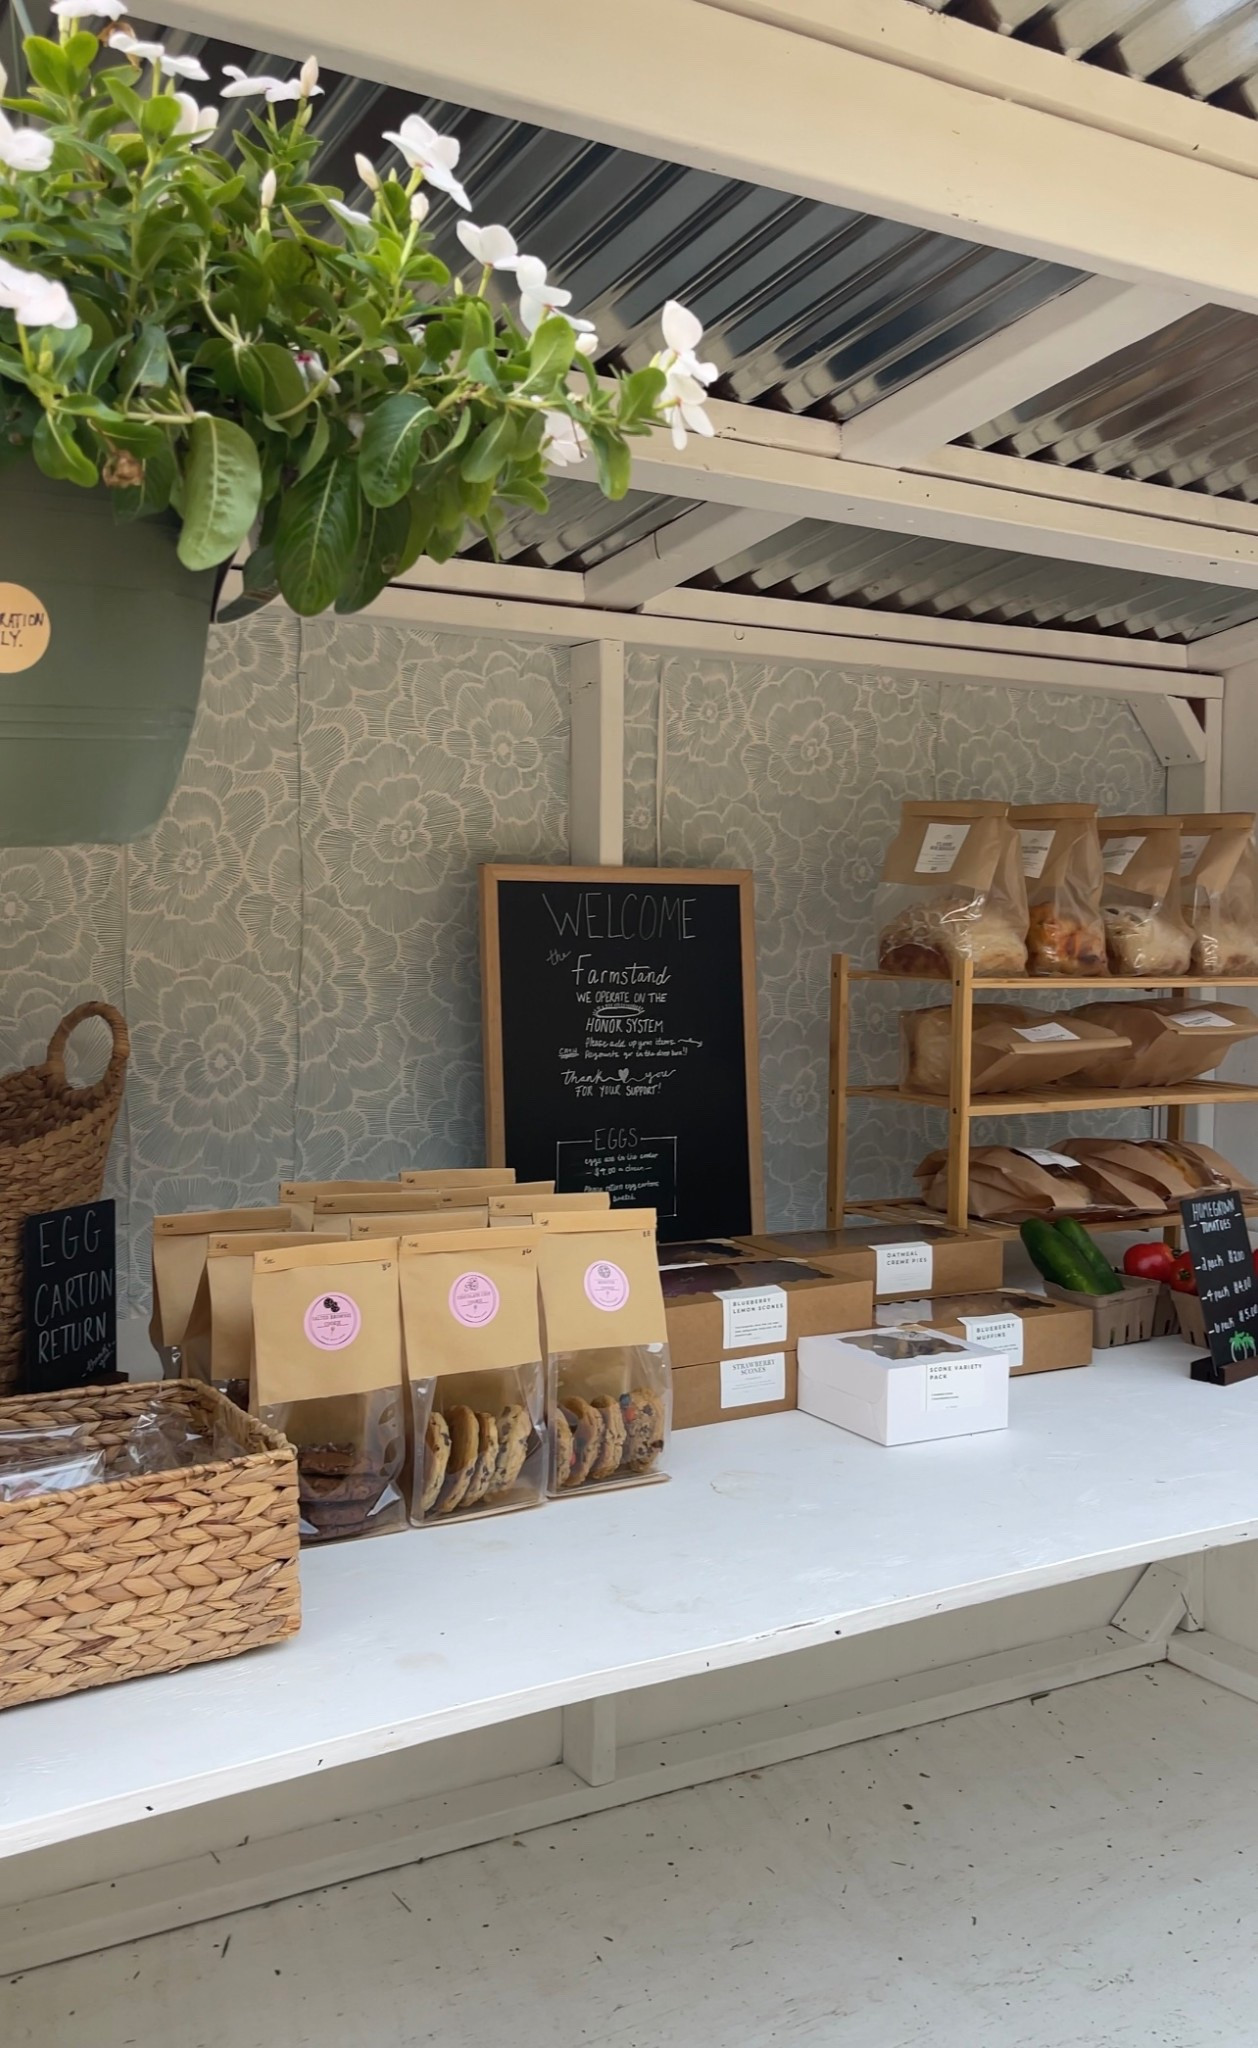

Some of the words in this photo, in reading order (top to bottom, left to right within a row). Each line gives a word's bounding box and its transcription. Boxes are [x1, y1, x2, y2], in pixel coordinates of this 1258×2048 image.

[542, 892, 697, 941] WELCOME
[571, 953, 672, 986] Farmstand
[576, 991, 592, 1004] WE
[595, 991, 630, 1004] OPERATE
[633, 991, 646, 1003] ON
[648, 991, 668, 1003] THE
[585, 1017, 623, 1034] HONOR
[625, 1018, 664, 1033] SYSTEM
[575, 1085, 594, 1098] FOR
[599, 1085, 621, 1098] YOUR
[625, 1082, 662, 1097] SUPPORT!
[594, 1127, 639, 1151] EGGS
[1192, 1197, 1236, 1222] HOMEGROWN
[1199, 1217, 1232, 1234] TOMATOES
[38, 1209, 102, 1268] EGG
[886, 1250, 919, 1258] OATMEAL
[886, 1258, 910, 1266] CREME
[34, 1268, 114, 1328] CARTON
[732, 1297, 772, 1307] BLUEBERRY
[732, 1307, 756, 1315] LEMON
[758, 1303, 784, 1312] SCONES
[976, 1322, 1016, 1334] BLUEBERRY
[38, 1311, 107, 1364] RETURN
[976, 1331, 1007, 1341] MUFFINS
[731, 1358, 776, 1371] STRAWBERRY
[740, 1366, 767, 1376] SCONES
[929, 1365, 952, 1373] SCONE
[954, 1363, 983, 1372] VARIETY
[929, 1373, 948, 1381] PACK
